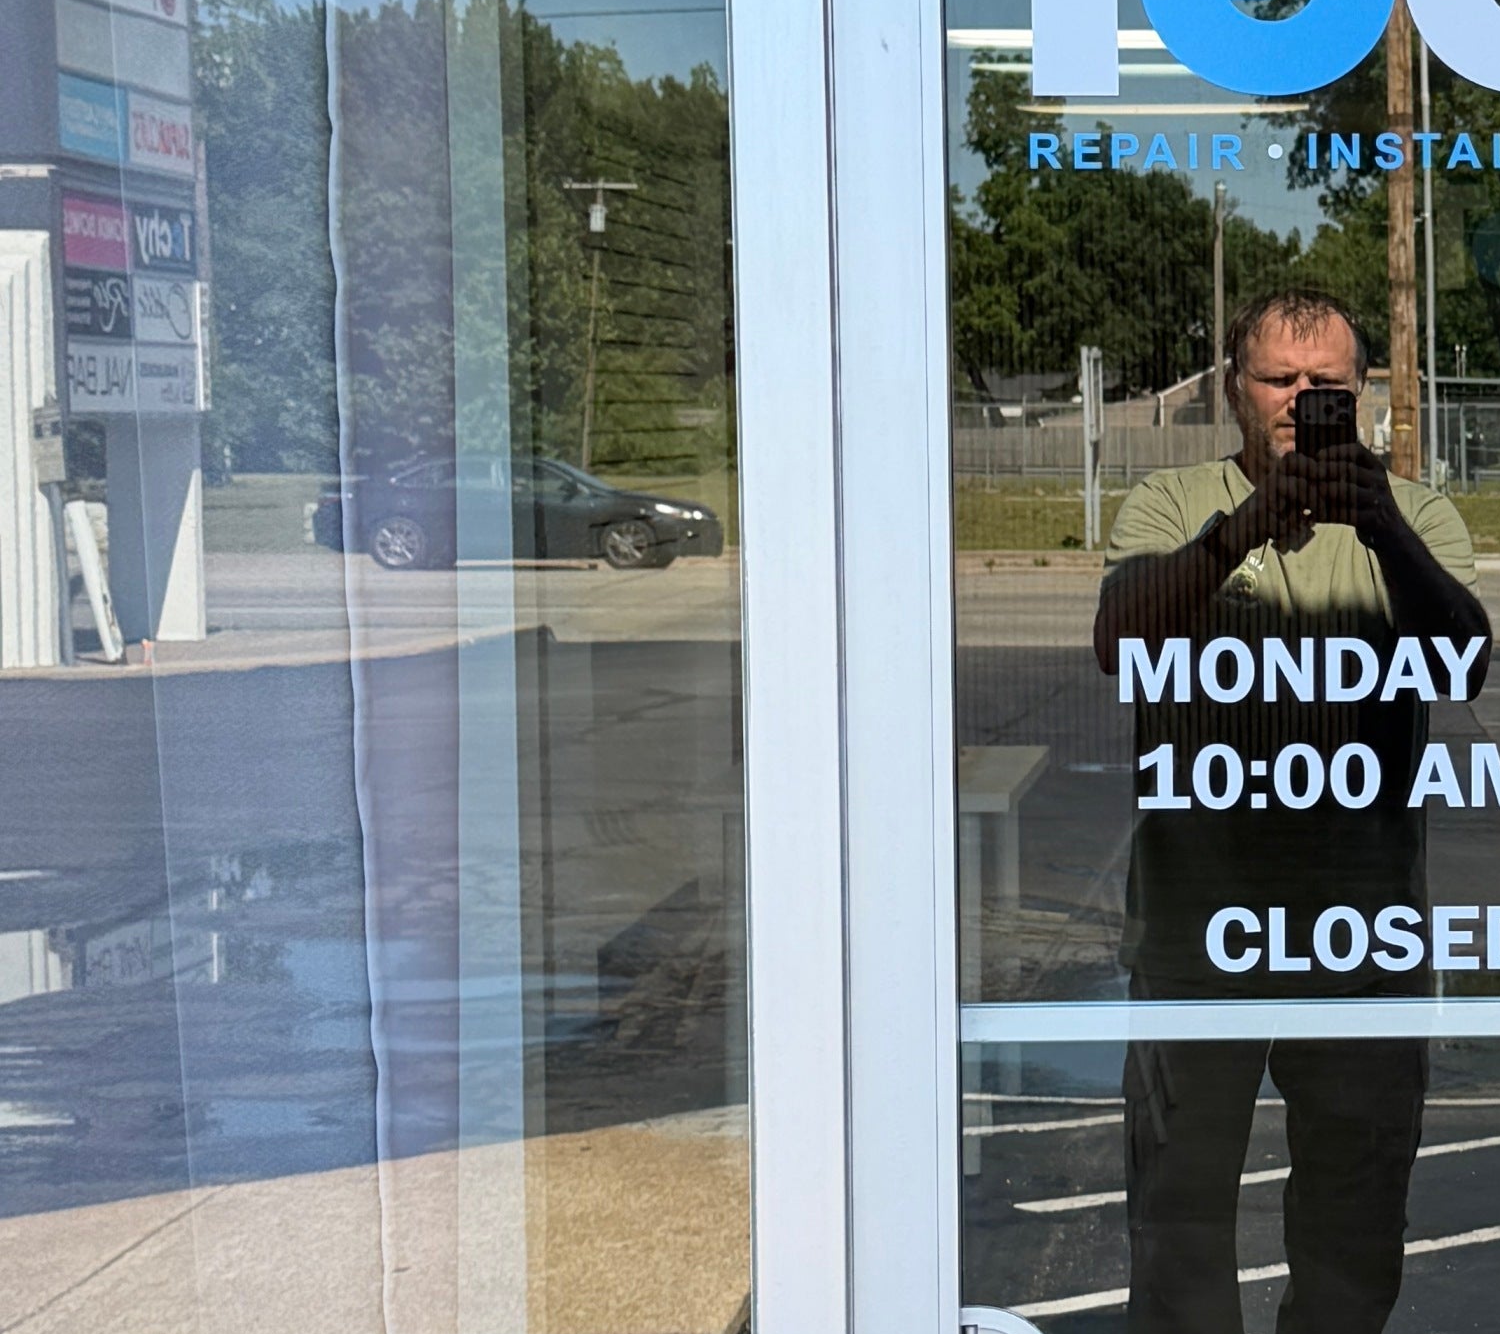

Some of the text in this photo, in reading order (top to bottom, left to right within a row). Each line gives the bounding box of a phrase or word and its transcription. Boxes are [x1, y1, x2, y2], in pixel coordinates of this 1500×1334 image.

[1028, 132, 1246, 173] REPAIR
[1118, 635, 1487, 704] MONDAY
[1137, 742, 1382, 811] 10:00
